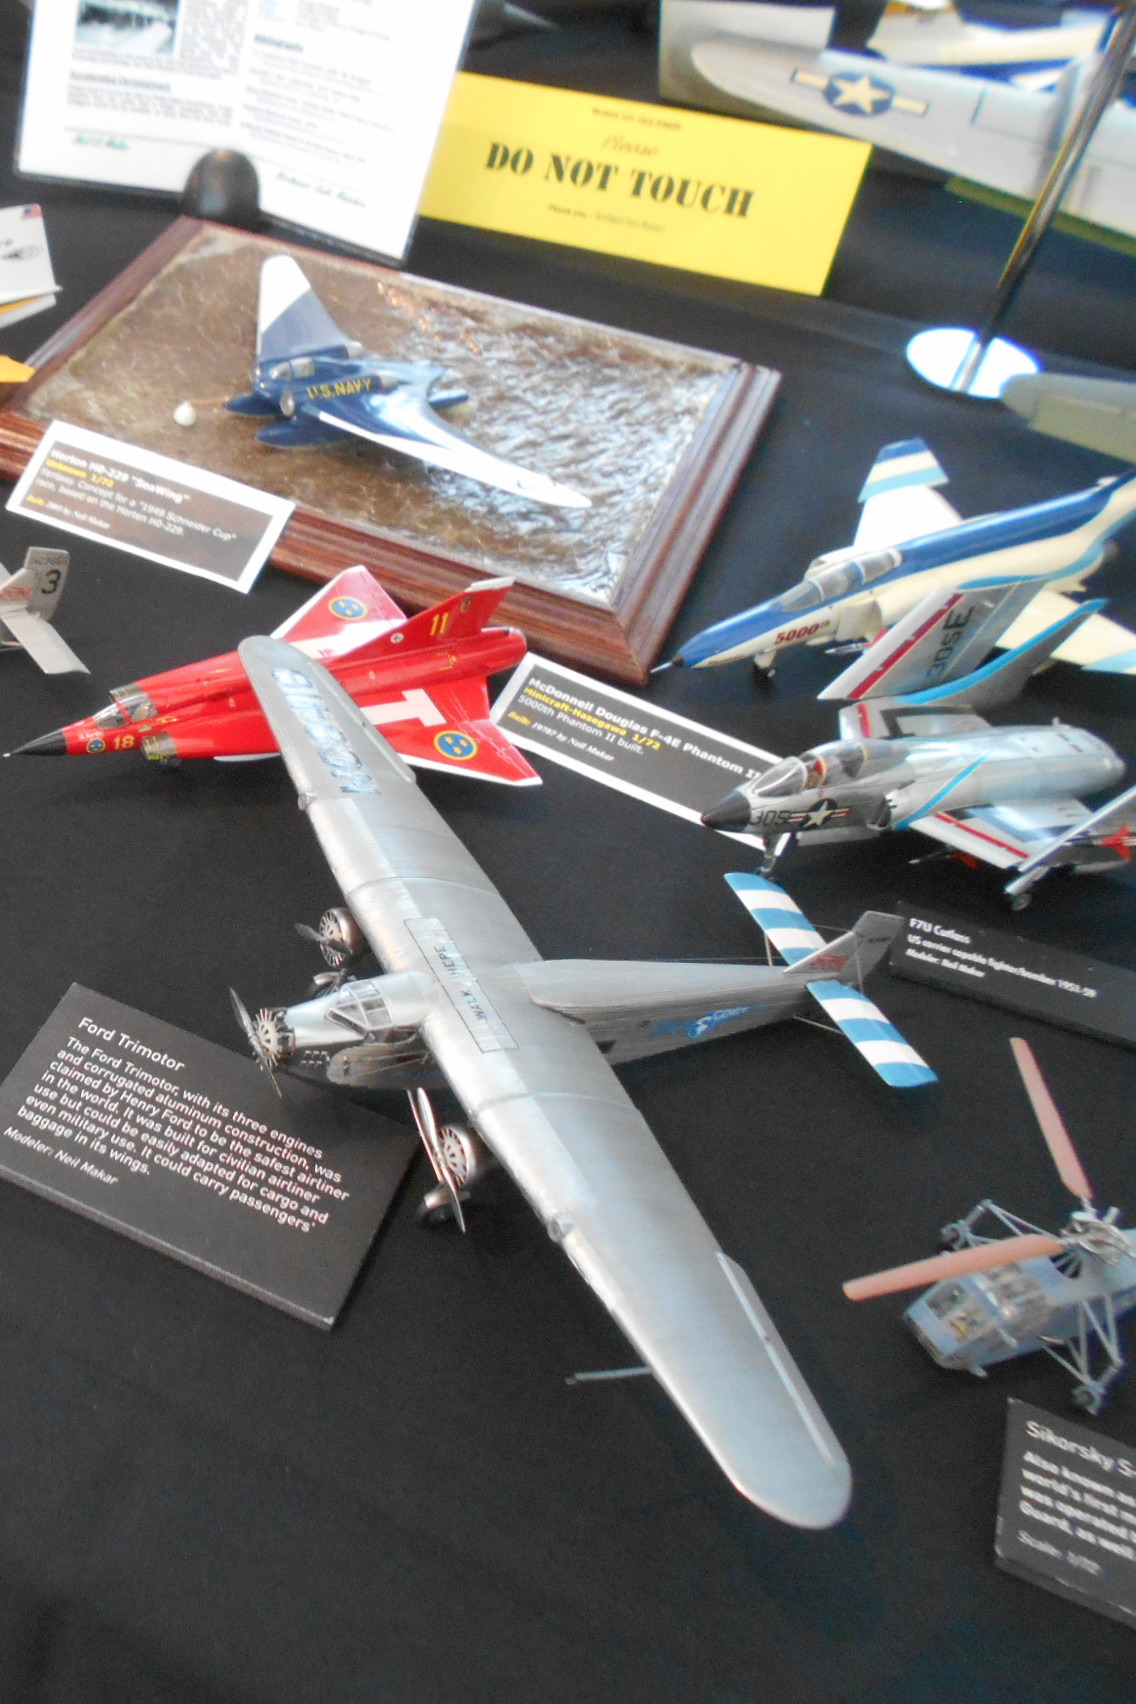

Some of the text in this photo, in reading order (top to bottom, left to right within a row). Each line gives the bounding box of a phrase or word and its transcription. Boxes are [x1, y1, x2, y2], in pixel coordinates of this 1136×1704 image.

[485, 141, 755, 218] DO NOT TOUCH
[41, 569, 61, 595] 3
[430, 613, 450, 636] 11
[113, 734, 135, 751] 18
[518, 695, 643, 754] 5000th Phantom II built.
[524, 687, 661, 750] Minicraft-Hasegawa 1/72
[529, 678, 594, 712] McDonnell
[595, 706, 648, 734] Douglas
[650, 729, 681, 748] F-4E
[683, 743, 743, 774] Phantom
[909, 918, 932, 932] F7U
[78, 1017, 184, 1070] Ford Trimotor
[50, 1061, 349, 1200] claimed by Henry Ford to be the safest airliner
[57, 1050, 341, 1183] and corrugated aluminum construction, was
[67, 1036, 322, 1159] The Ford Trimotor, with its three engines
[4, 1127, 118, 1184] Modeler: Neil Makar
[17, 1106, 150, 1175] baggage in its wings.
[26, 1096, 315, 1232] even military use. It could carry passengers'
[34, 1084, 329, 1224] use but could be easily adapted for cargo and
[41, 1070, 320, 1203] in the world. It was built for civilian airliner
